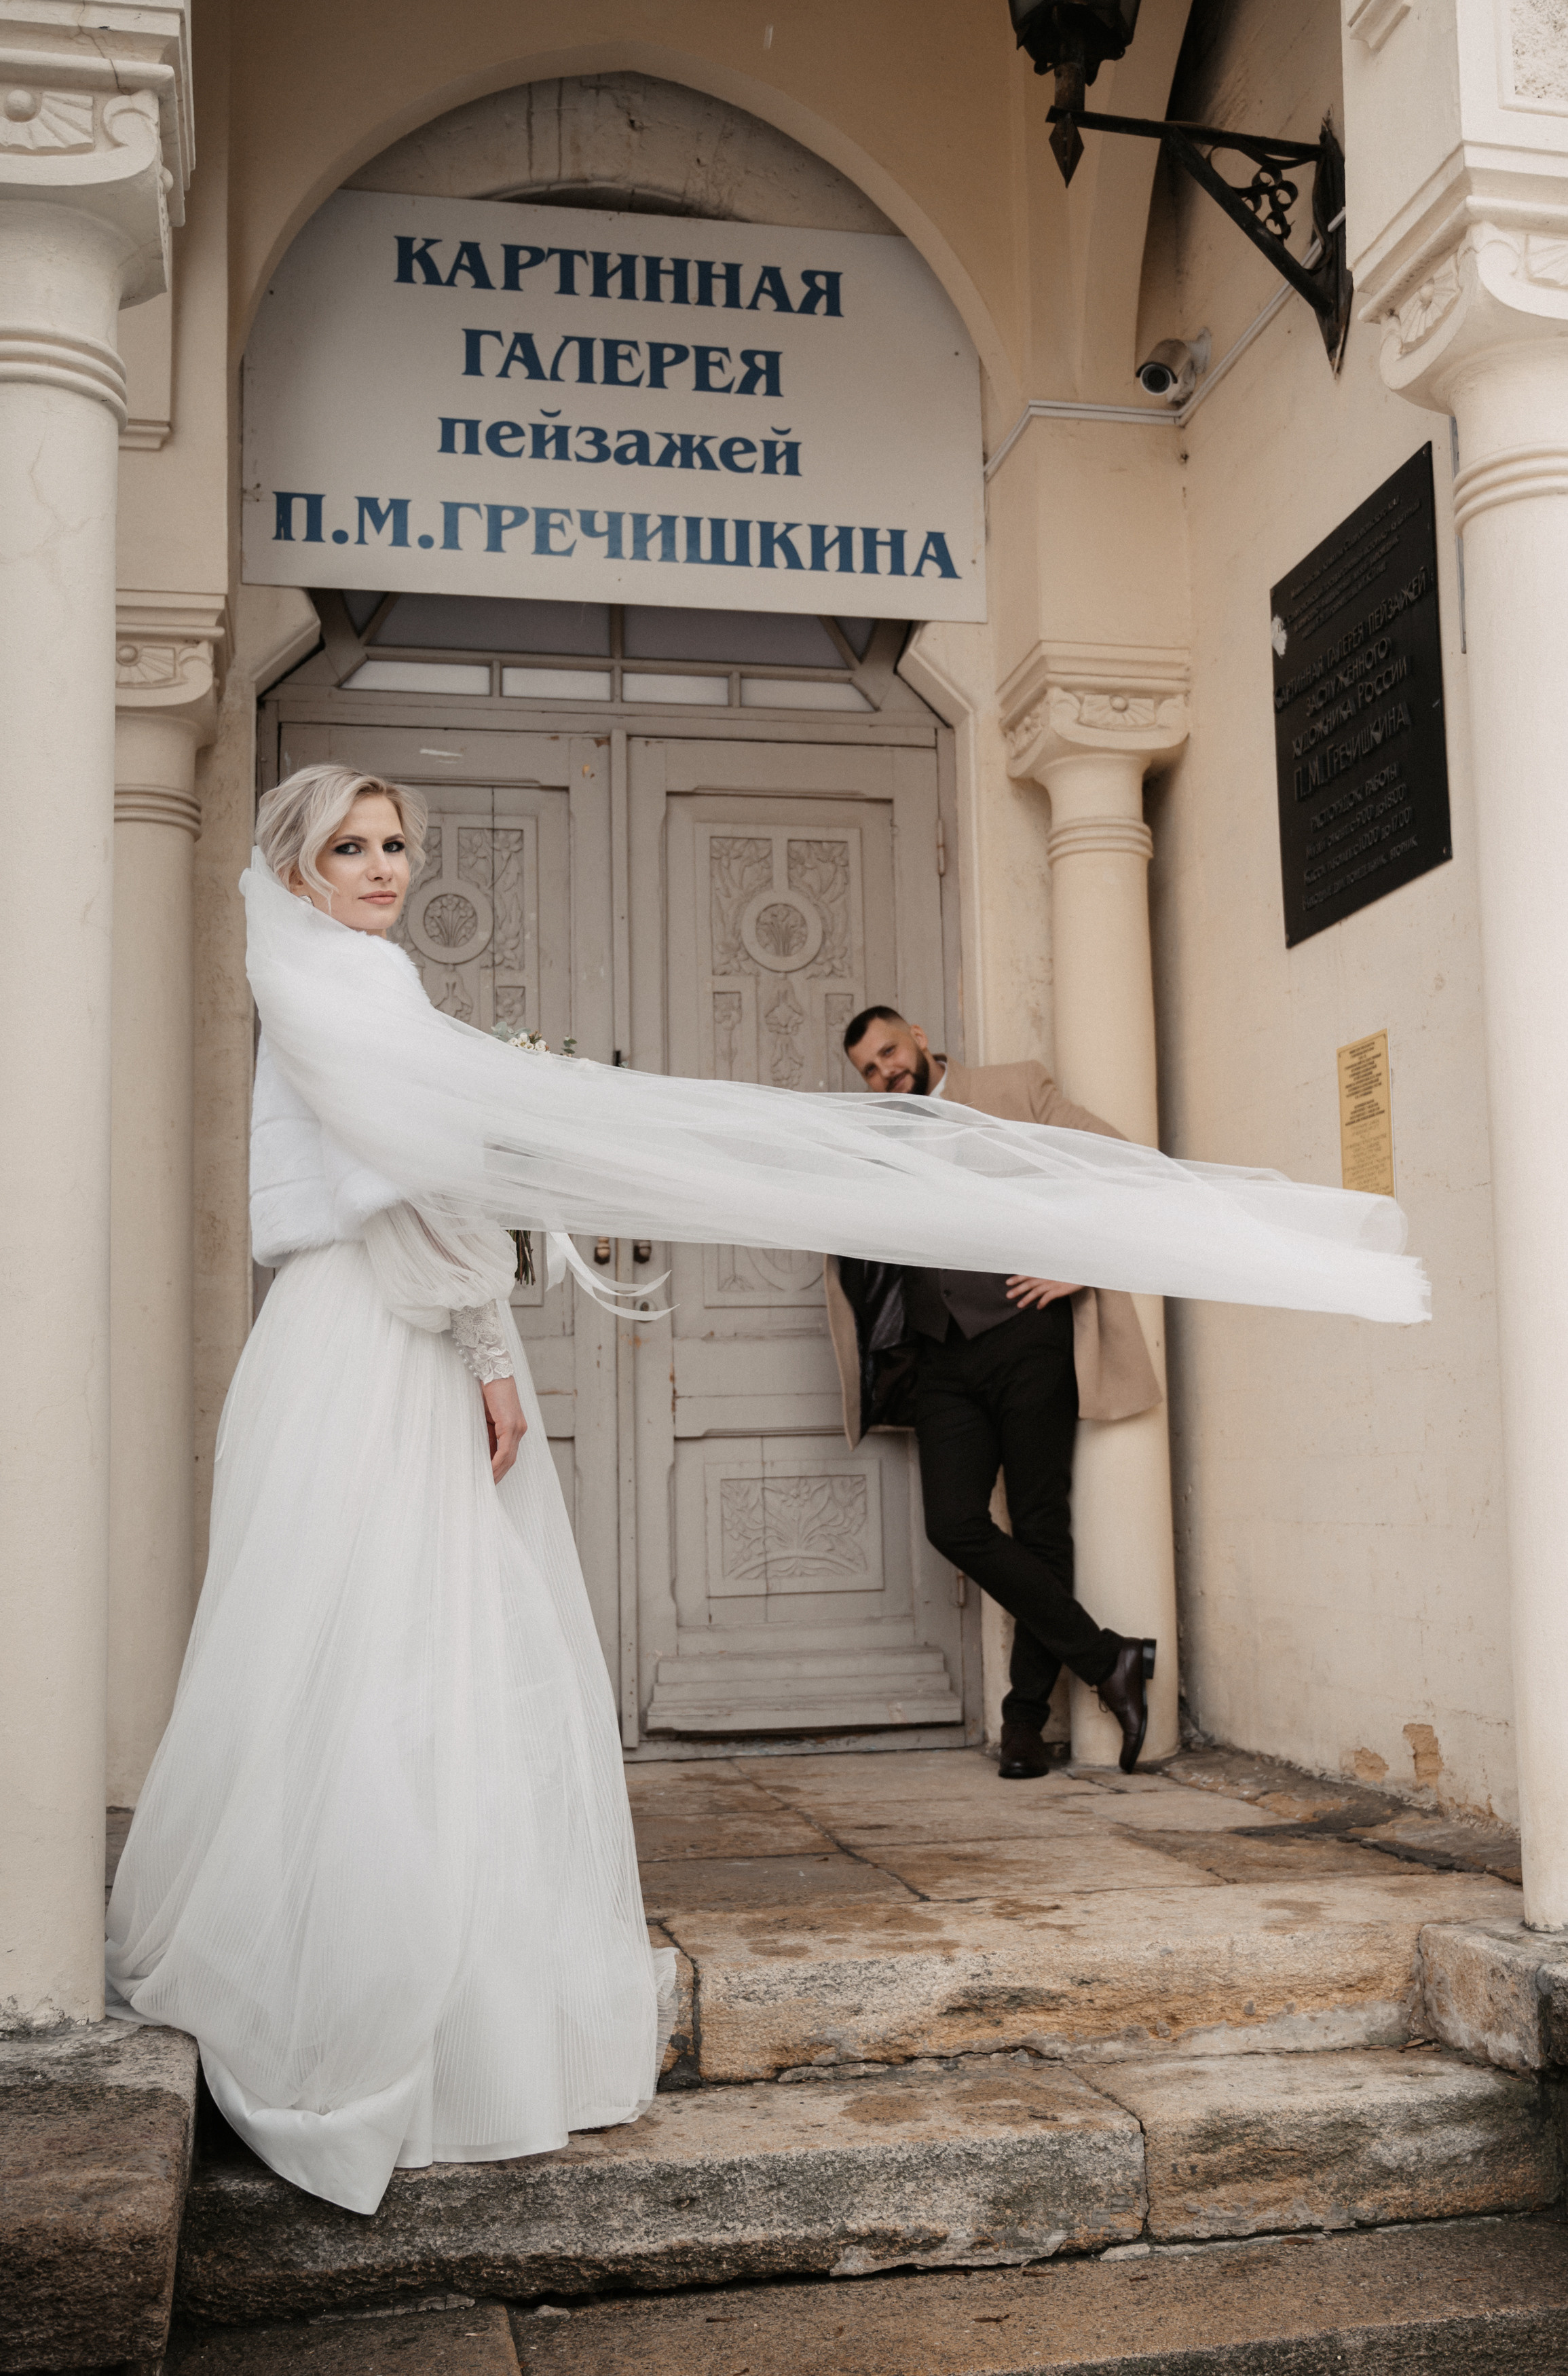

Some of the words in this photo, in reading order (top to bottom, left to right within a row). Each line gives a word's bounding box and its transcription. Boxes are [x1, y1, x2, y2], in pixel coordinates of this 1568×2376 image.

[394, 236, 843, 316] КАРТИННАЯ
[461, 329, 783, 396] ГАЛЕРЕЯ
[436, 410, 802, 475] пейзажей
[272, 491, 961, 578] П.М.ГРЕЧИШКИНА
[1326, 620, 1364, 669] ГАЛЕРЕЯ
[1367, 564, 1426, 636] ПЕЙЗАЖЕЙ
[1291, 694, 1354, 761] ХУДОЖНИКА
[1357, 648, 1407, 710] РОССИИ
[1305, 635, 1387, 718] ЗАСЛУЖЕННОГО
